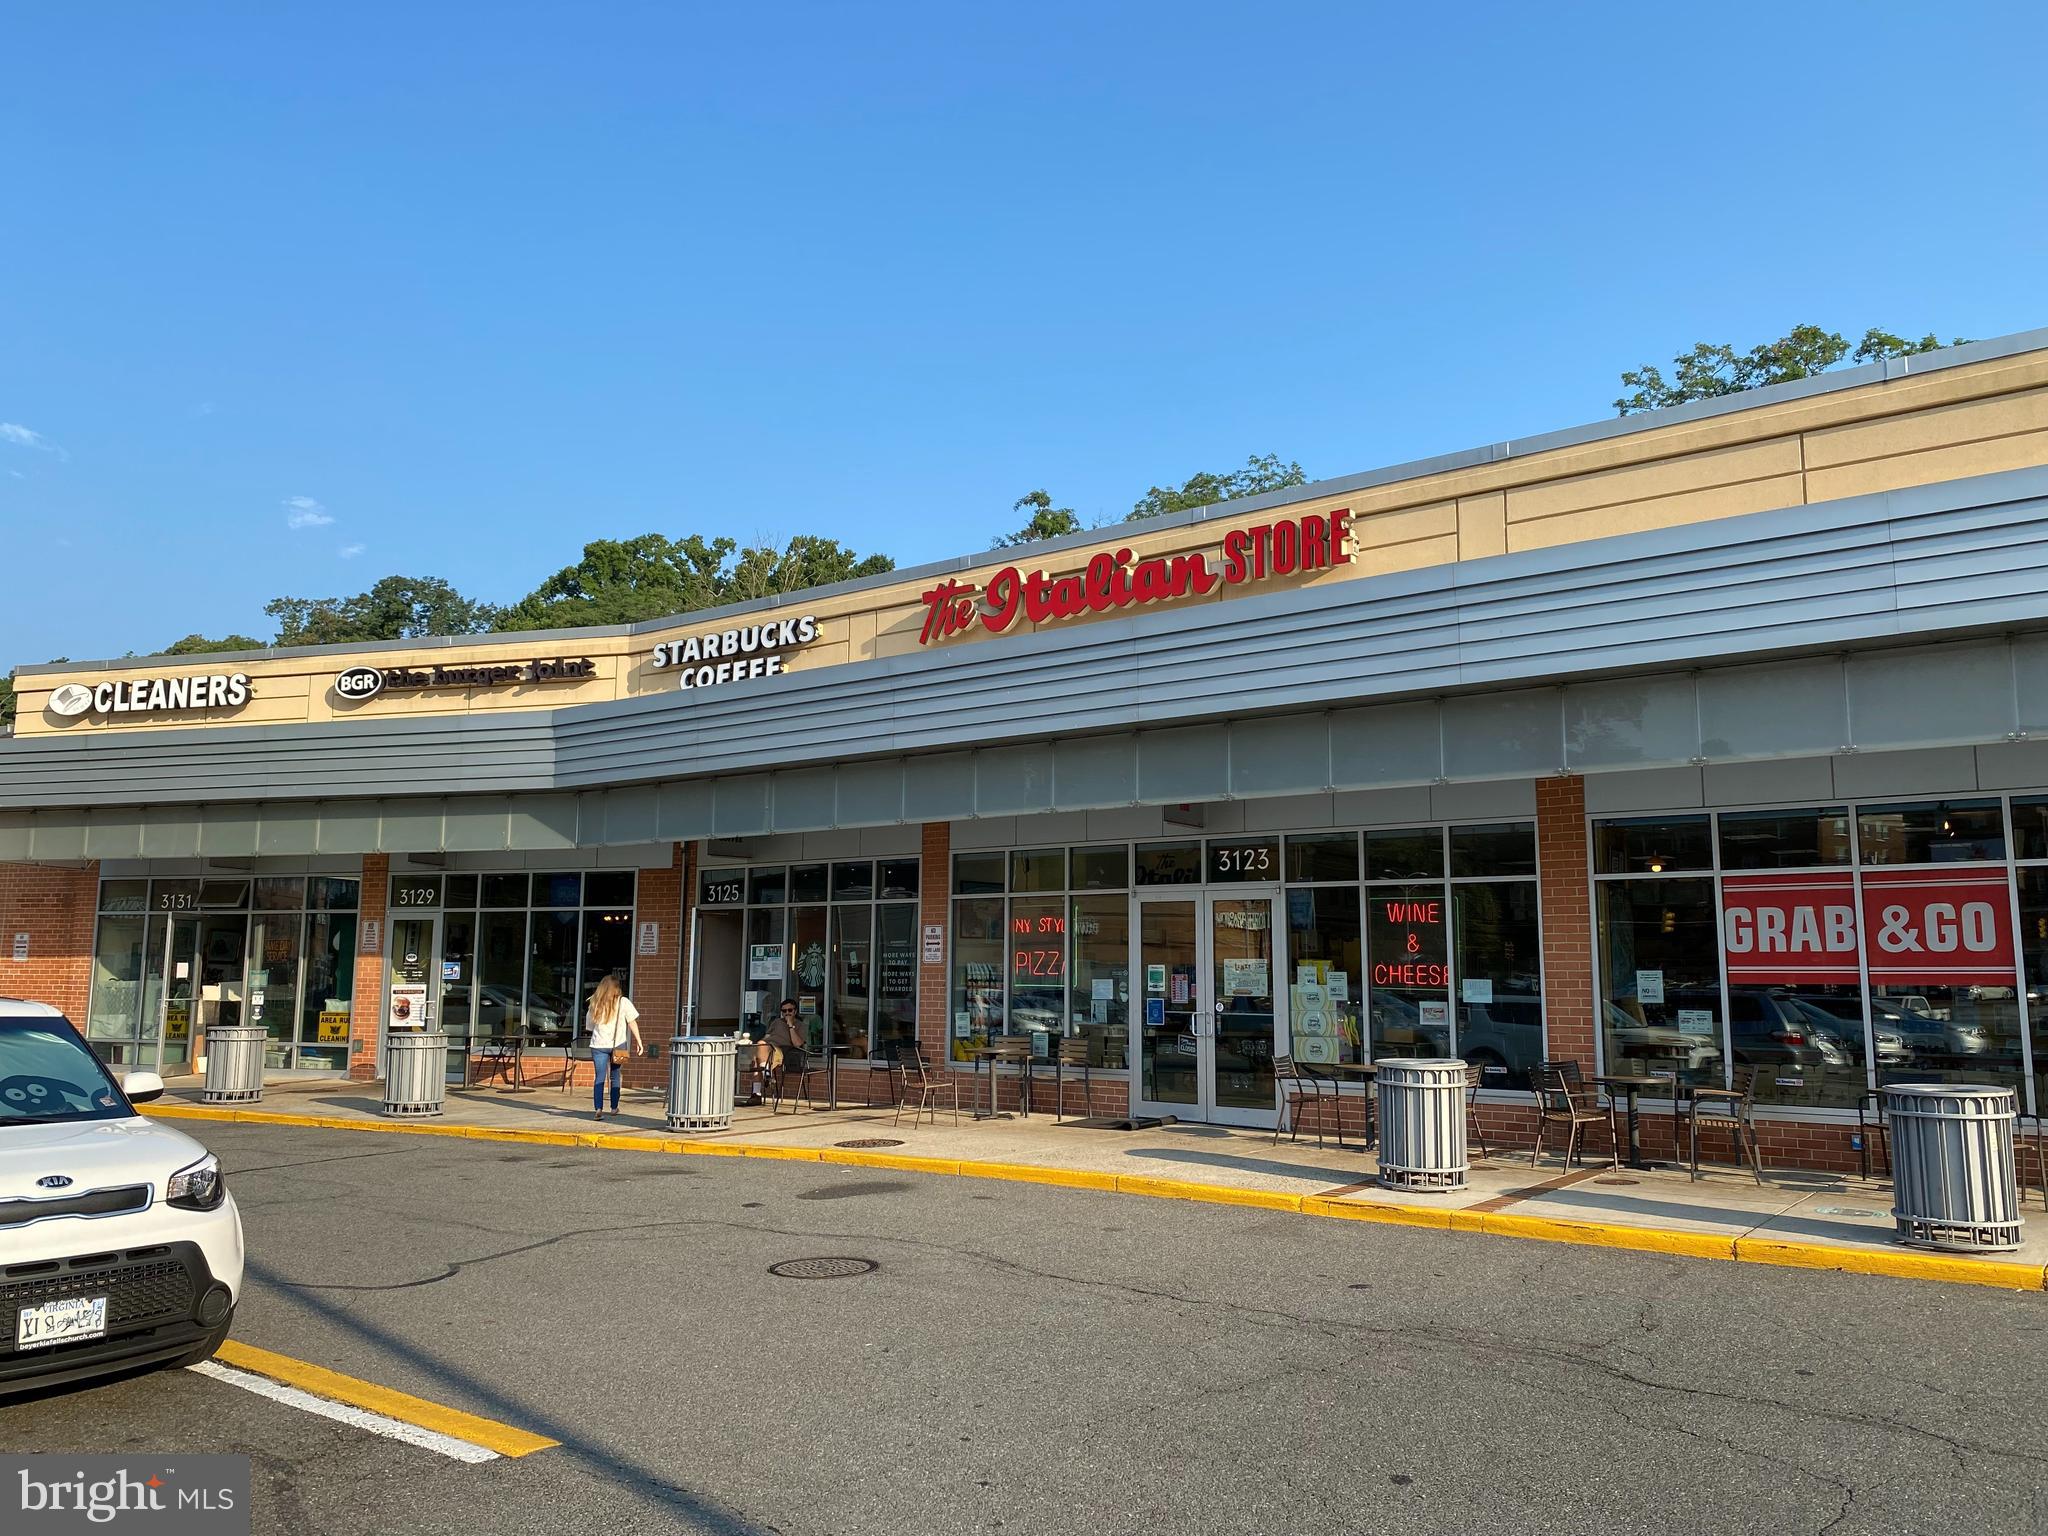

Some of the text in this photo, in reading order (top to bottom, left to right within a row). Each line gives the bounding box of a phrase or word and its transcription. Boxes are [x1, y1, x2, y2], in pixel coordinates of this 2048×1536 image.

[919, 508, 1351, 645] The Italian STORE
[652, 615, 816, 668] STARBUCKS
[340, 673, 375, 691] BGR
[387, 657, 595, 688] the burger joint
[680, 655, 782, 690] COFFEE
[94, 673, 247, 713] CLEANERS
[1219, 848, 1270, 871] 3123
[161, 894, 192, 909] 3131
[399, 888, 435, 905] 3129
[708, 884, 739, 902] 3125
[1387, 903, 1439, 923] WINE
[1015, 917, 1031, 934] NY
[1724, 905, 1857, 953] GRAB
[1407, 933, 1420, 953] &
[42, 1176, 69, 1187] KIA
[43, 1301, 85, 1313] VIRGINIA
